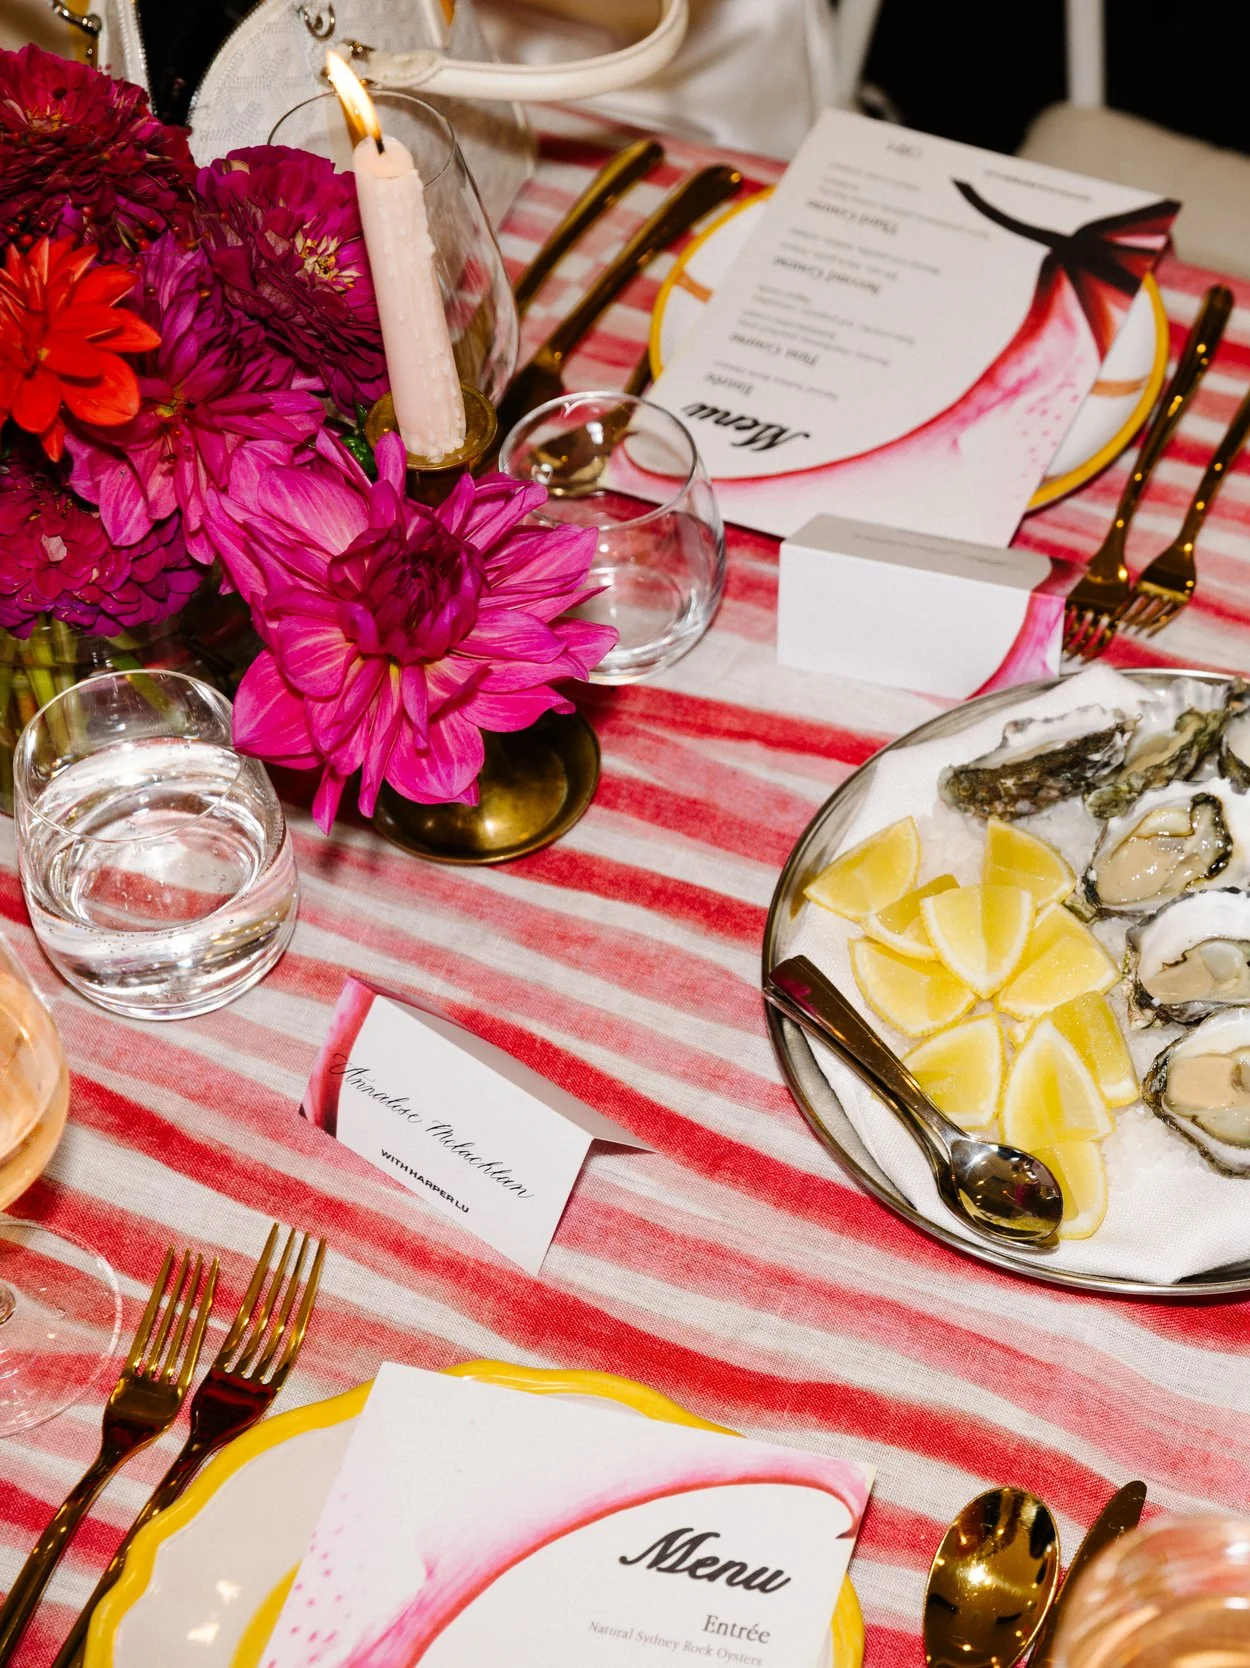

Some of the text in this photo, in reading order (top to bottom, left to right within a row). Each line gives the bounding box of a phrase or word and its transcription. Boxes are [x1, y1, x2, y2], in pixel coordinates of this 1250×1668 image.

[681, 402, 811, 452] Menu
[381, 1149, 470, 1214] WITH HARPER LU
[618, 1527, 791, 1594] Menu
[588, 1620, 763, 1667] Natural Sydney Rock Oysters
[703, 1614, 771, 1644] Entrée
